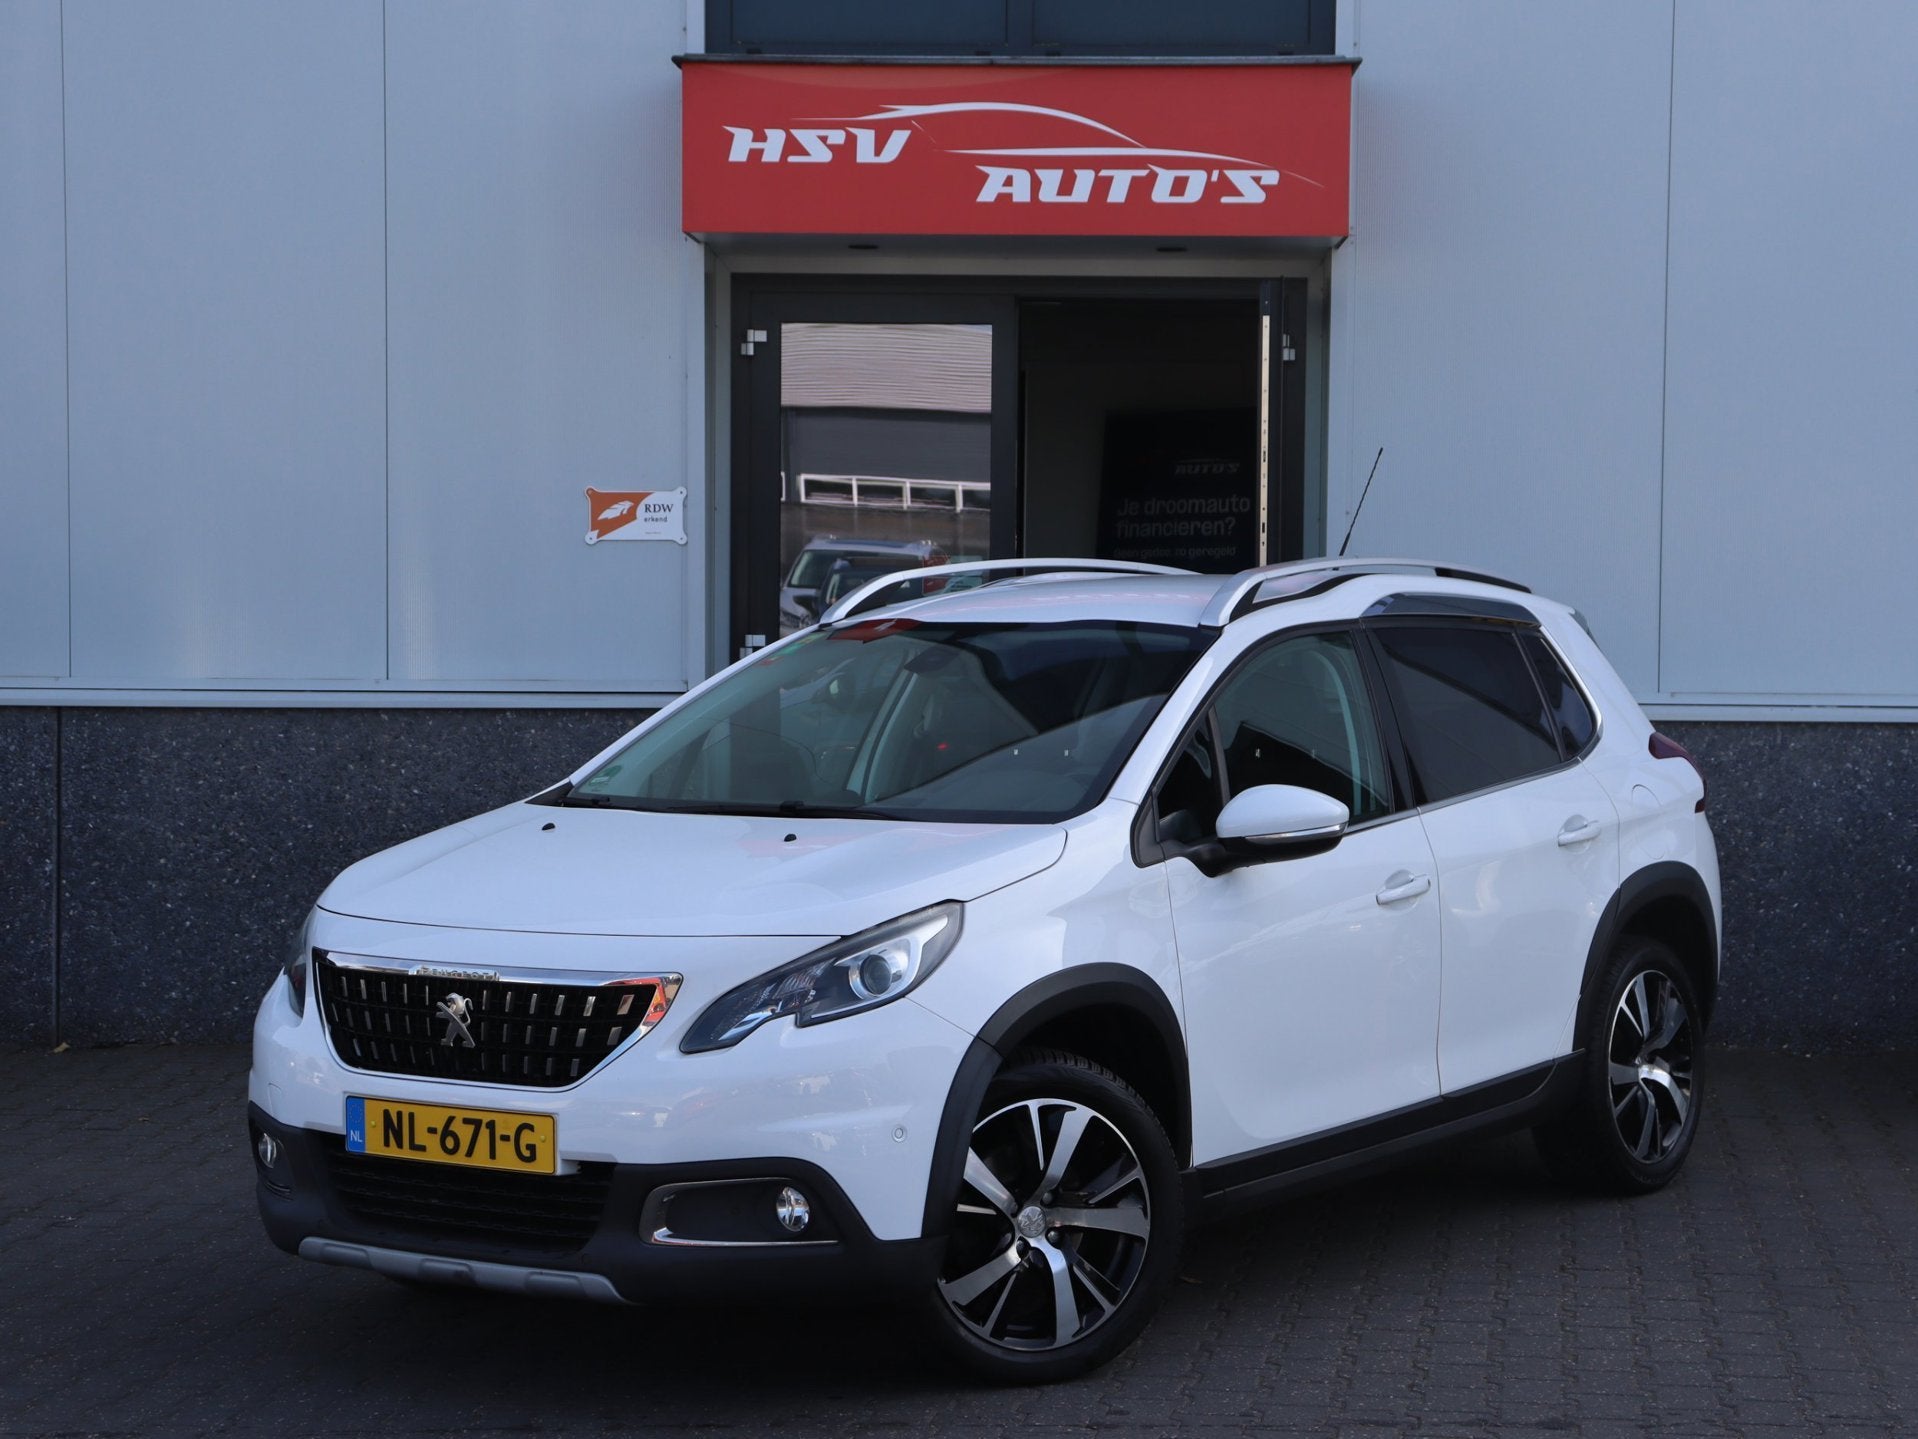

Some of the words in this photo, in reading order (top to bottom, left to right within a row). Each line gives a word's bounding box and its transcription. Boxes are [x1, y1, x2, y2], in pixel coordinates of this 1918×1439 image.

[722, 125, 911, 163] HSV
[975, 164, 1280, 204] AUTO'S
[644, 504, 674, 513] RDW
[1117, 498, 1140, 516] Je
[1144, 495, 1251, 515] droomauto
[1116, 516, 1236, 538] financieren?
[350, 1130, 362, 1143] NL
[382, 1108, 537, 1163] NL-671-G
